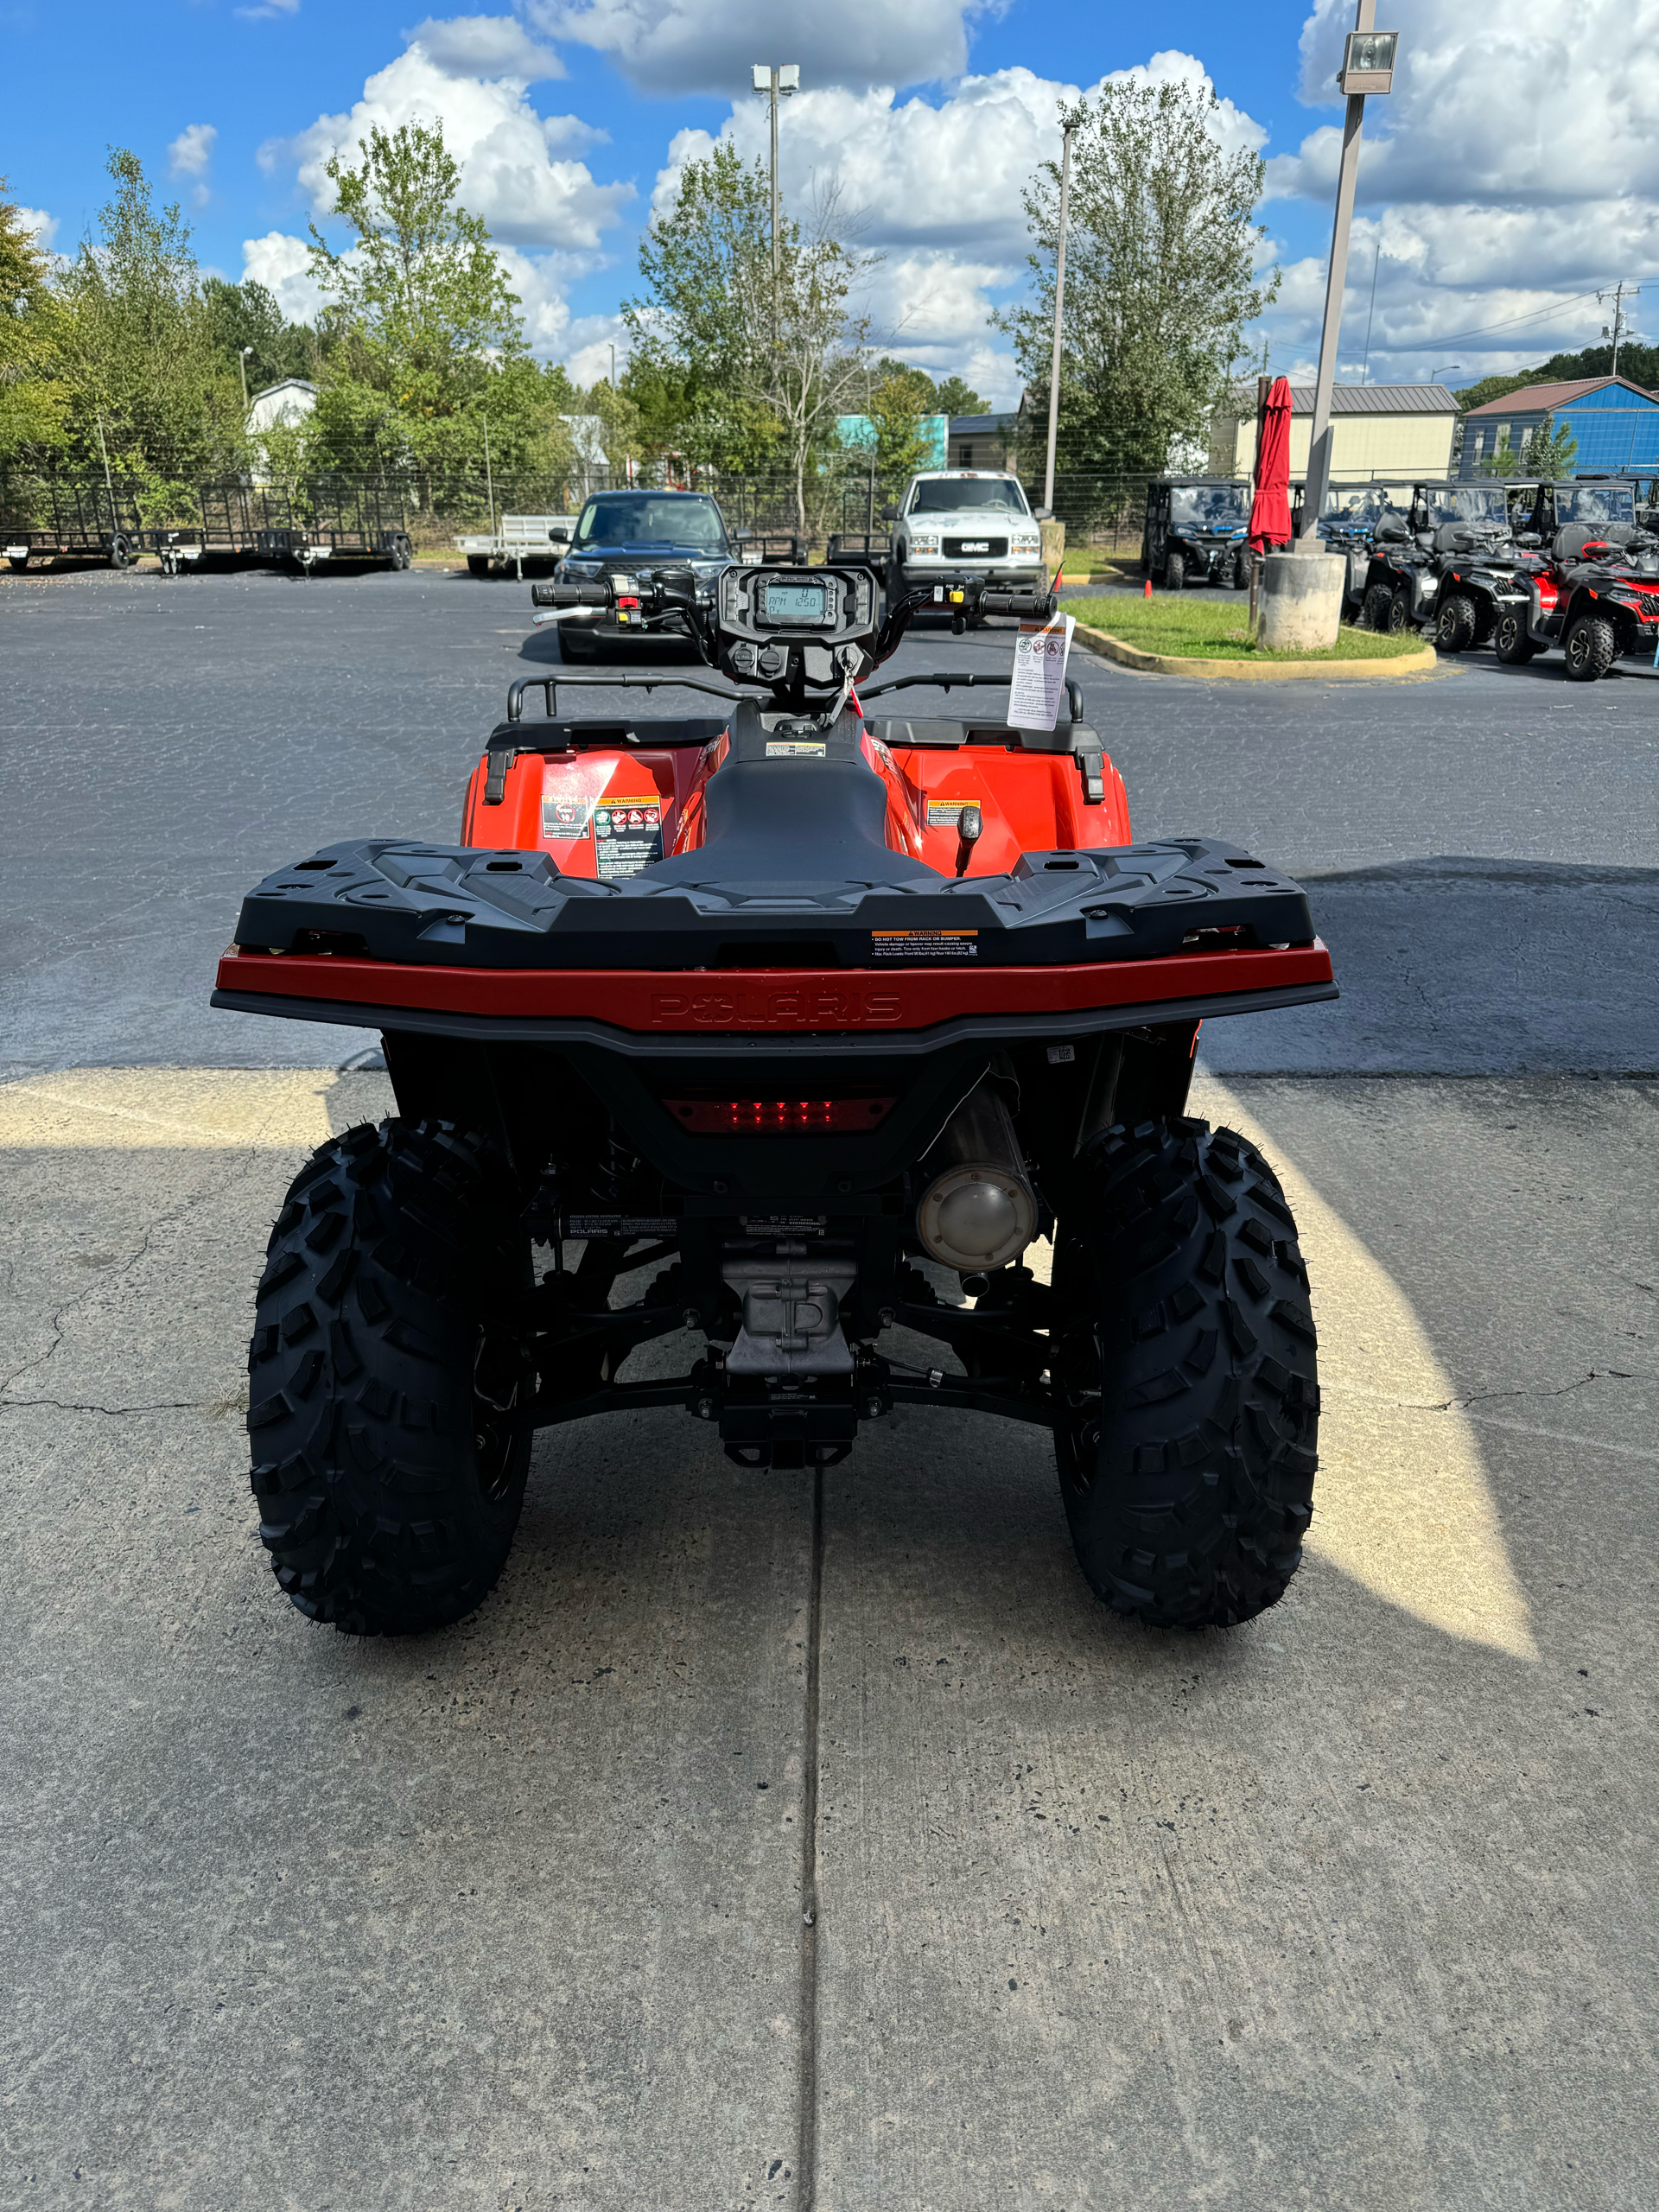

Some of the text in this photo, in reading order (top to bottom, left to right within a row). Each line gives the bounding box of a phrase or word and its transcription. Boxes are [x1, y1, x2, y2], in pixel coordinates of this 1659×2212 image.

[961, 542, 989, 552] GMC
[802, 588, 809, 597] 0
[769, 596, 817, 607] RPM 1250
[651, 992, 903, 1023] POLARIS
